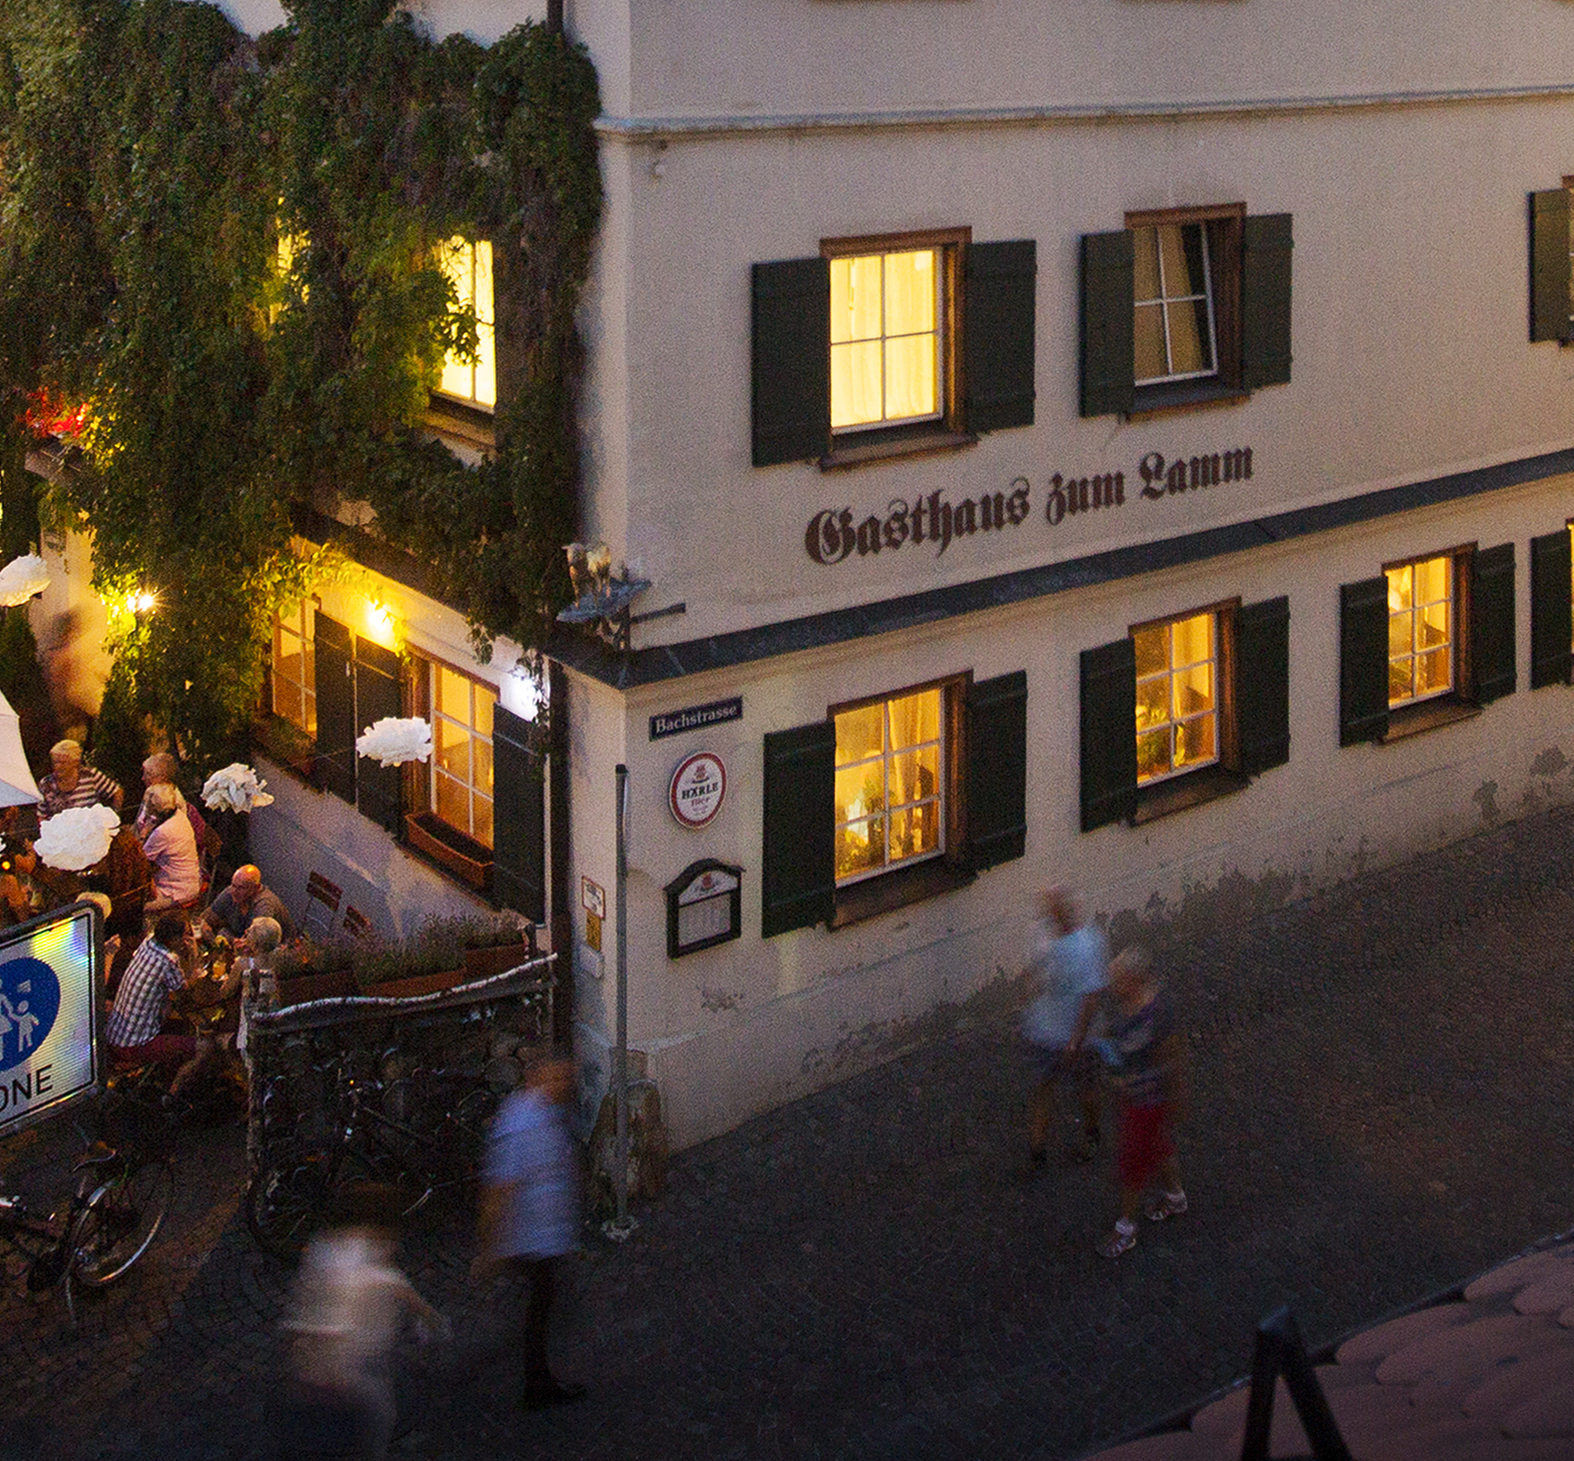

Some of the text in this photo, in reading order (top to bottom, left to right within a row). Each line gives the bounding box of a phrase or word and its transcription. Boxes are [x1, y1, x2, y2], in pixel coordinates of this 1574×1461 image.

[804, 446, 1254, 565] Gasthaus zum Lamm
[656, 706, 737, 733] Bachstrasse
[682, 782, 719, 799] HÄRLE
